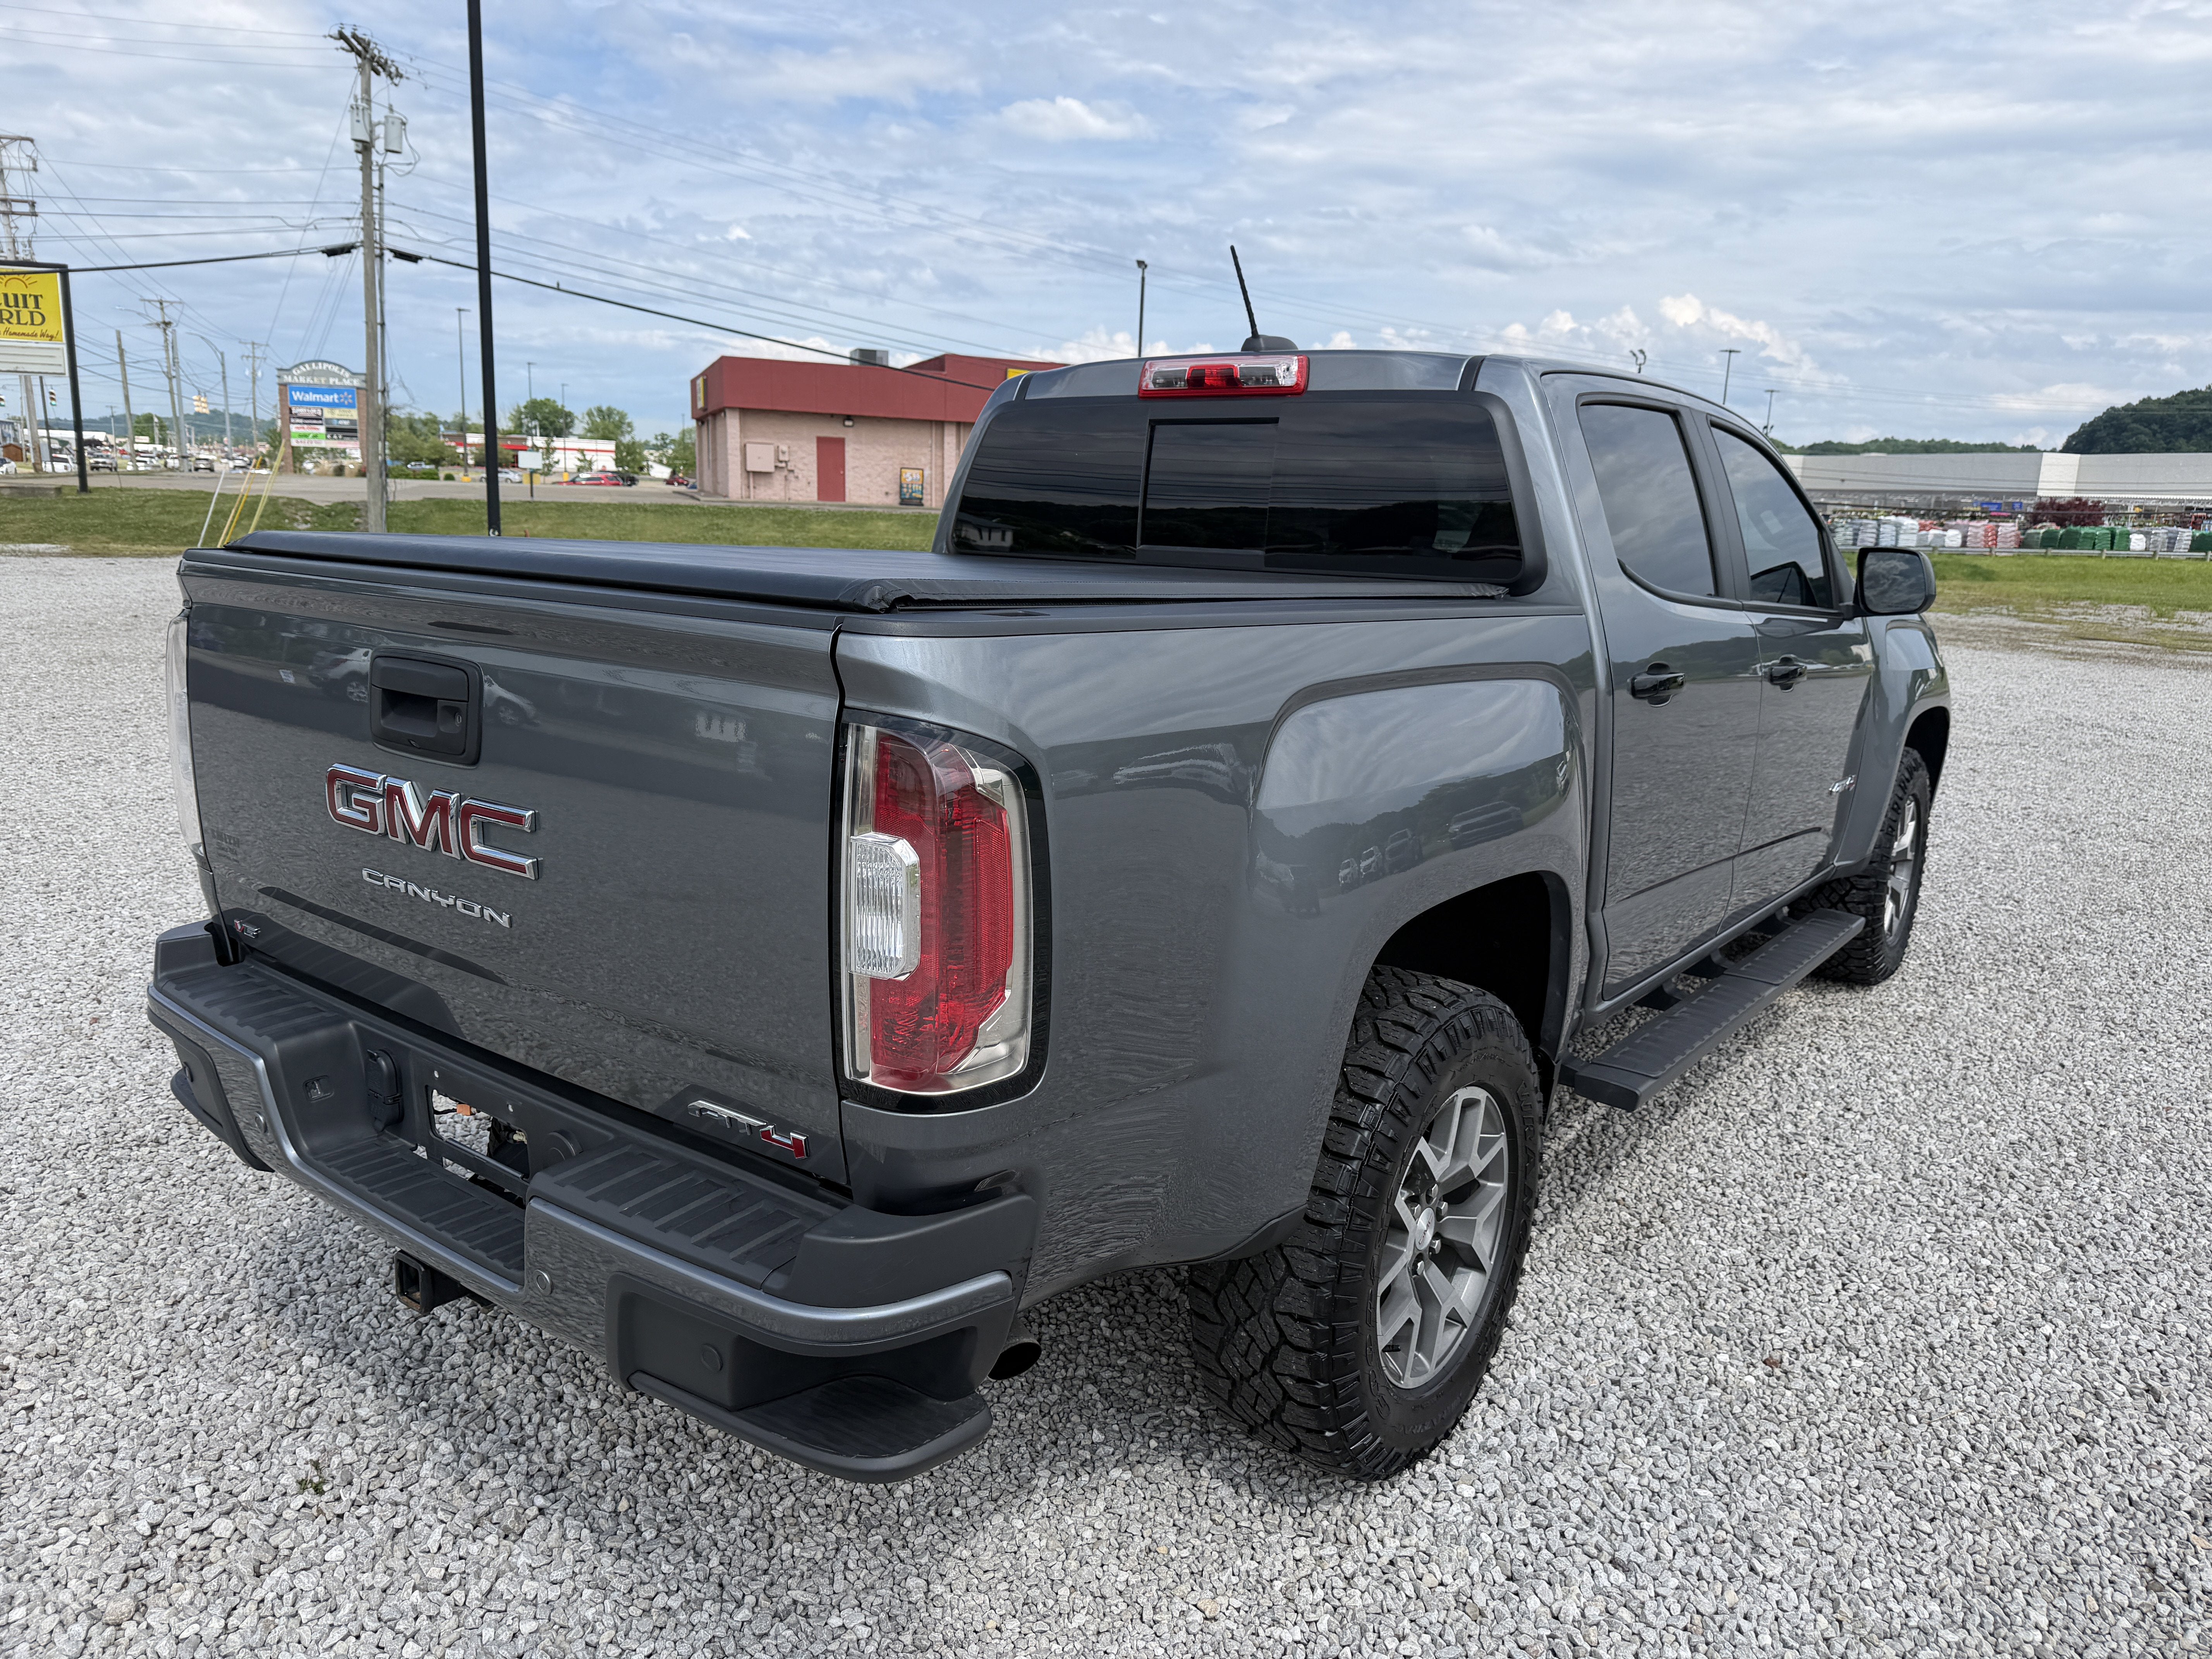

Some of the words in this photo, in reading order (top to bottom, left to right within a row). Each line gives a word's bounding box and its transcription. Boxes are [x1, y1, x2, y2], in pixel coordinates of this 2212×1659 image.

[0, 292, 43, 309] UIT
[3, 327, 38, 337] Homemade
[40, 329, 59, 341] Way!
[292, 362, 351, 378] GALLIPOLIS
[283, 374, 326, 384] MARKET
[330, 377, 361, 386] PLACE
[292, 390, 339, 403] Walmart
[326, 763, 541, 880] GMC
[362, 868, 512, 928] CANYON
[687, 1099, 811, 1160] AT4
